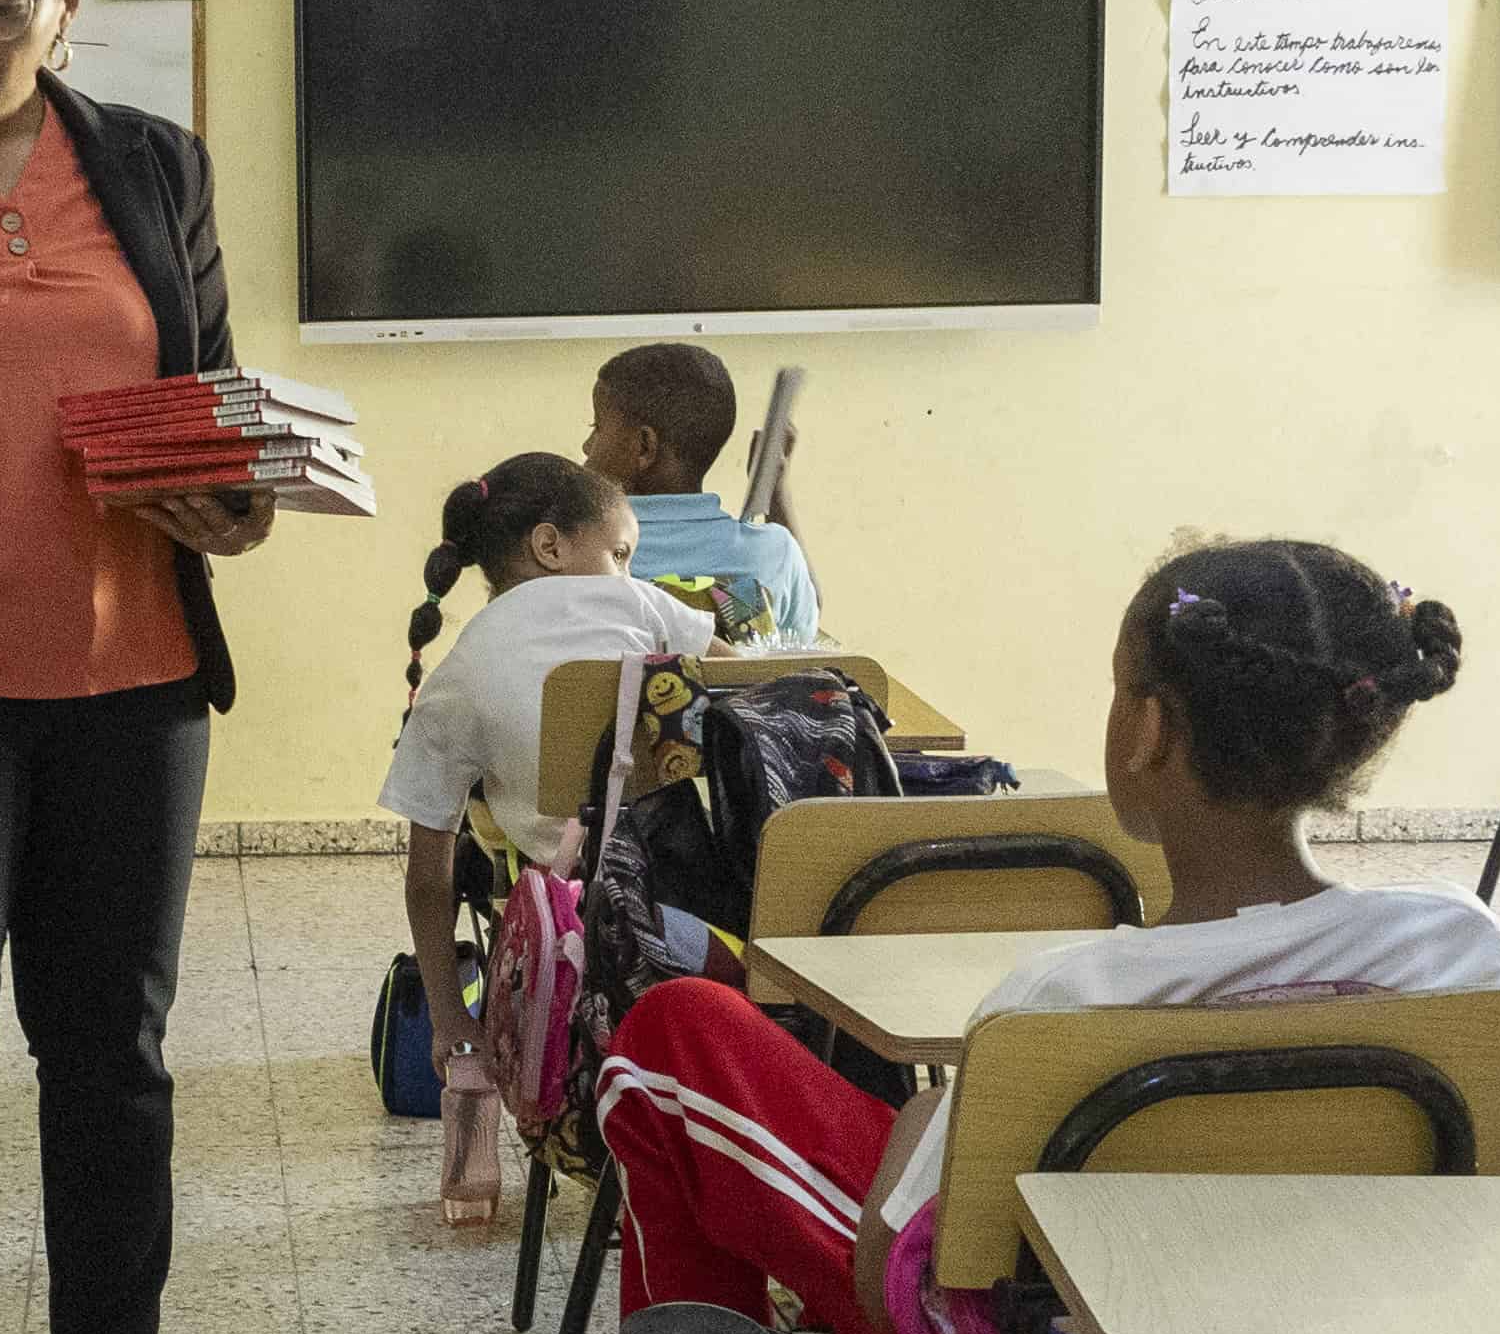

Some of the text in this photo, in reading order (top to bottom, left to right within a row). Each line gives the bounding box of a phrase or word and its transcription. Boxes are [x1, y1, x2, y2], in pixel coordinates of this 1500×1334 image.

[1190, 16, 1228, 51] En
[1233, 31, 1271, 53] este
[1180, 111, 1228, 147] Leer
[1232, 130, 1257, 150] y
